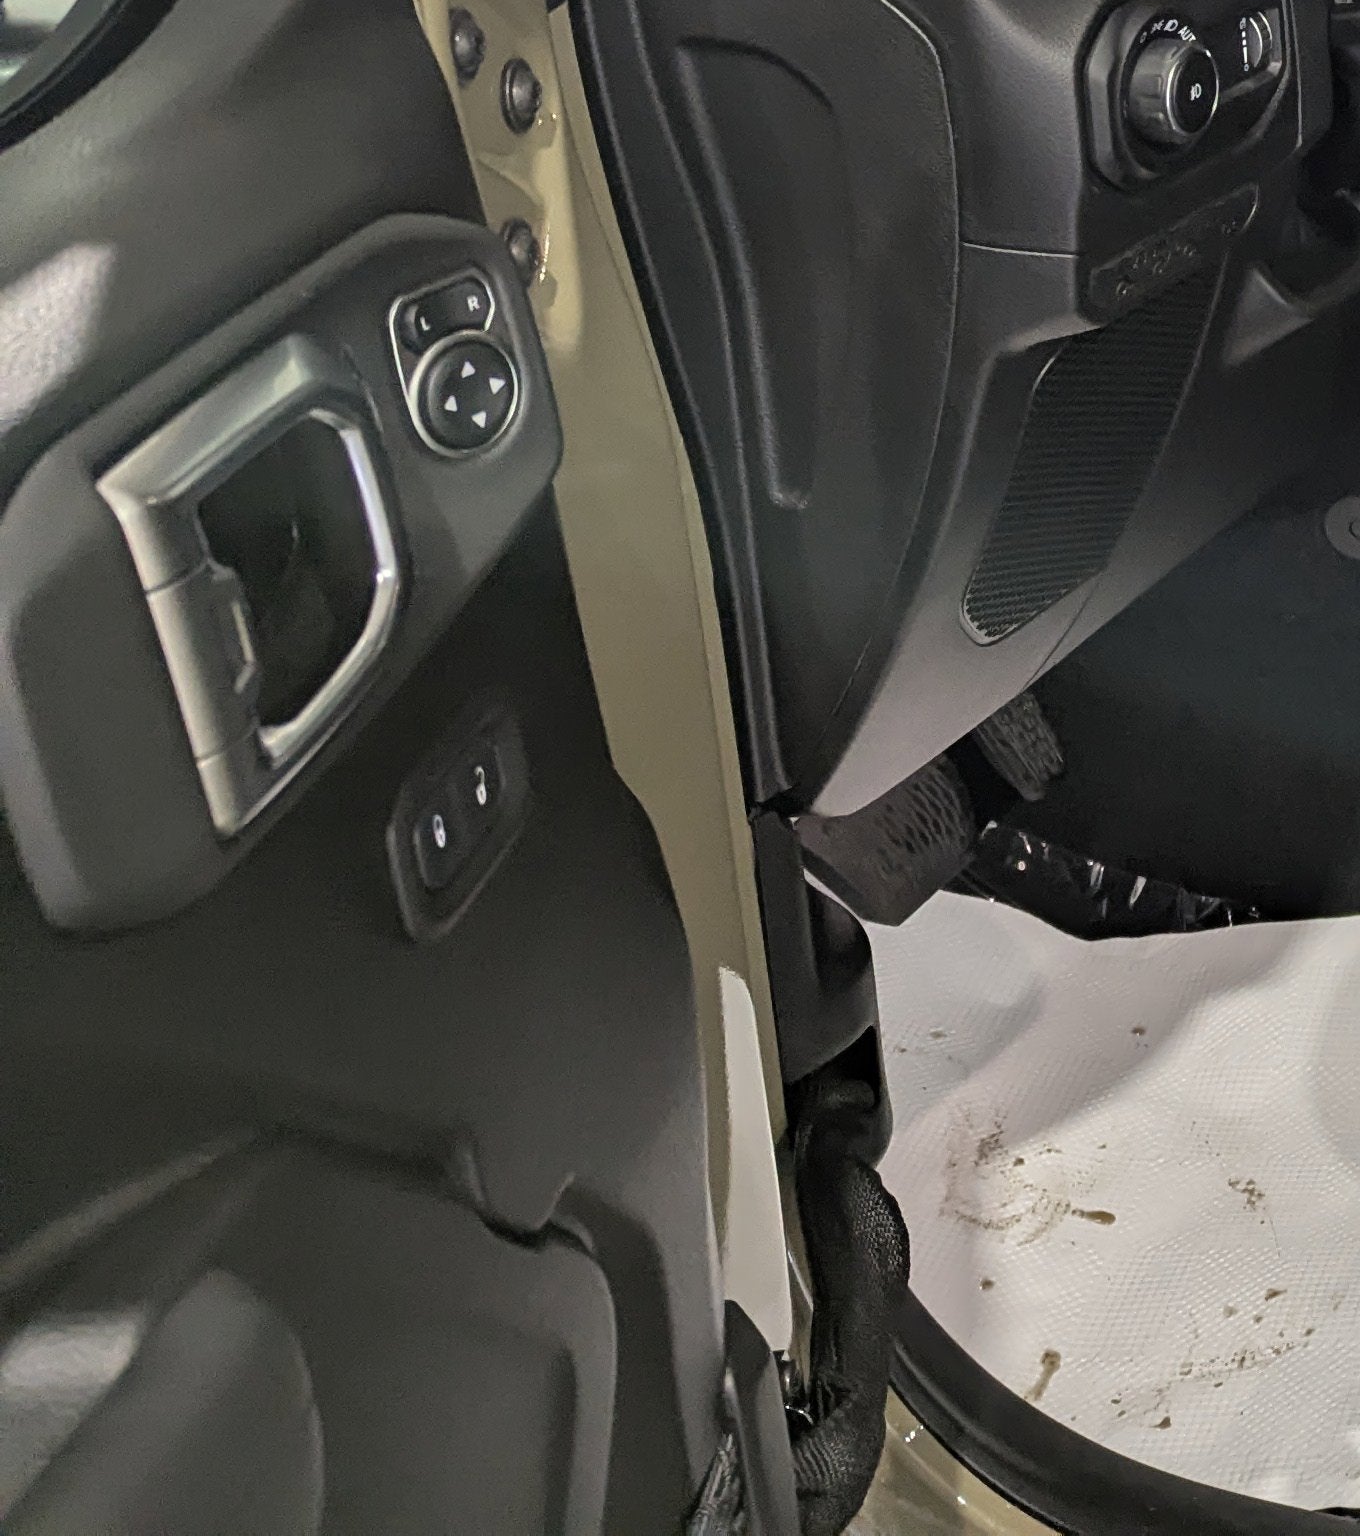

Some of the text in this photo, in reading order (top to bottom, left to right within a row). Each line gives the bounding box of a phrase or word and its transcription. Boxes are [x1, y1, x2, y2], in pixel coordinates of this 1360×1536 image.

[1177, 25, 1198, 42] AUT
[419, 294, 481, 332] L R
